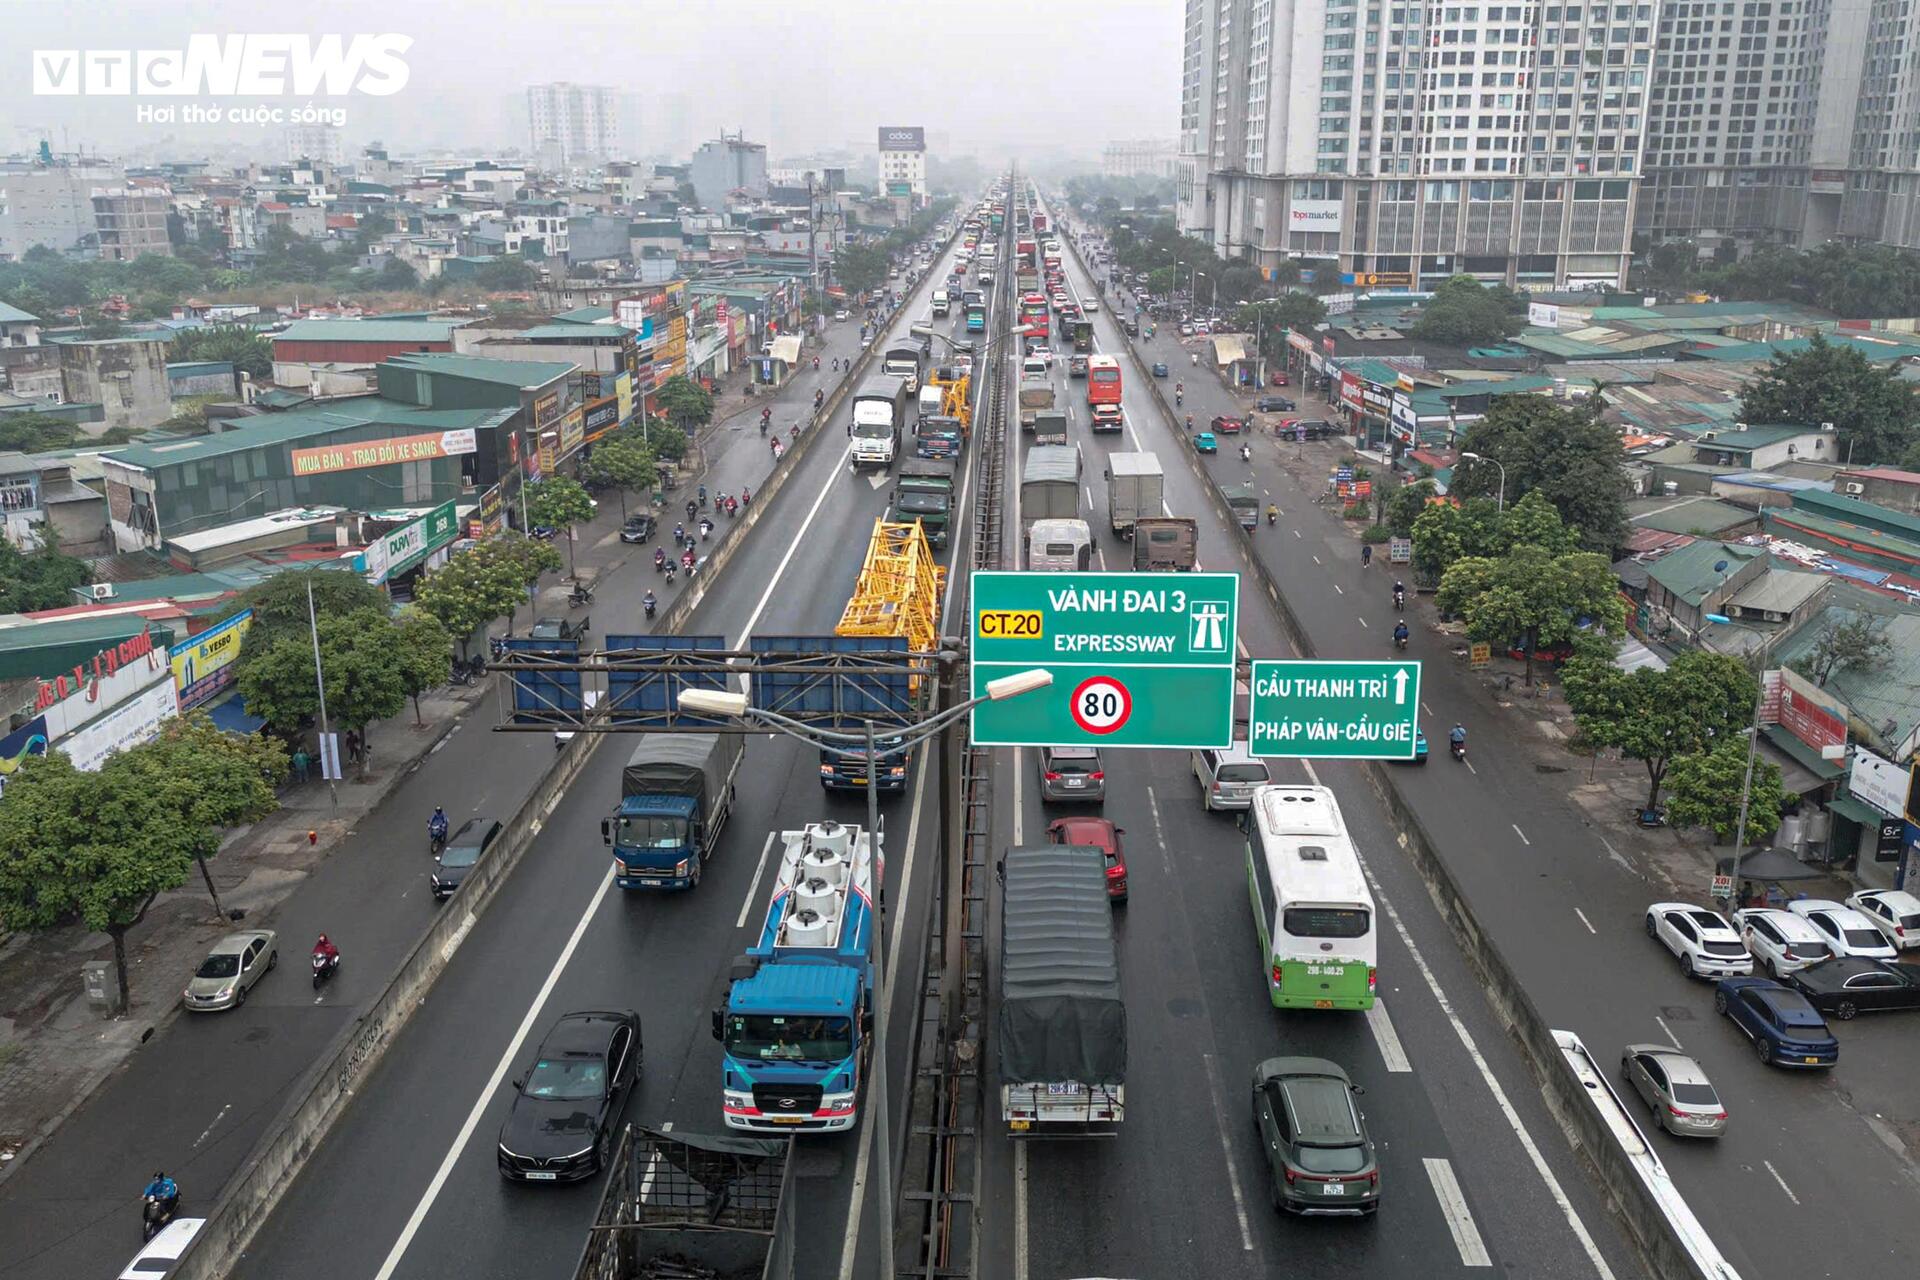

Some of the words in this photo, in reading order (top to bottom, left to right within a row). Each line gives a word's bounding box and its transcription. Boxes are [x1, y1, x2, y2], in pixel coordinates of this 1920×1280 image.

[1047, 584, 1116, 613] VÀNH
[1122, 590, 1166, 613] ĐAI
[1170, 590, 1186, 613] 3
[980, 613, 1041, 635] CT.20
[1054, 634, 1176, 653] EXPRESSWAY
[1256, 669, 1291, 697] CẦU
[1294, 679, 1354, 697] THANH
[1358, 673, 1387, 698] TRÌ
[1084, 693, 1117, 717] 80
[1254, 716, 1302, 741] PHÁP
